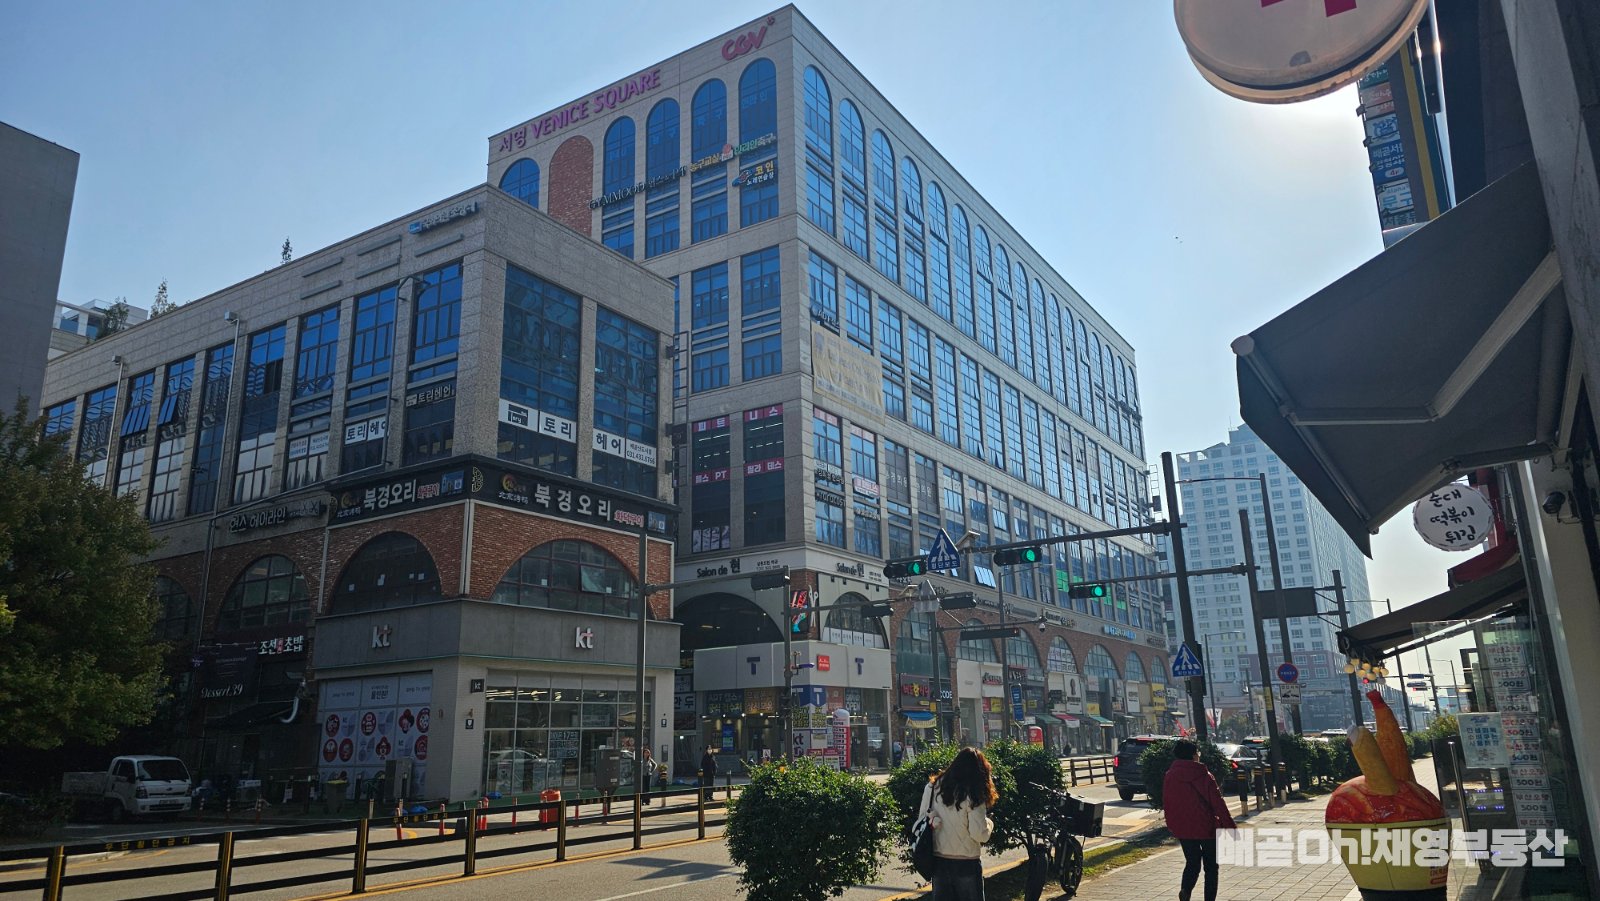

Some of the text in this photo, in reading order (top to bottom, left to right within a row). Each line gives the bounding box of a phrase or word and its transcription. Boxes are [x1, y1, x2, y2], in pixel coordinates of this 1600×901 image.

[721, 25, 769, 61] CGV
[498, 68, 662, 153] 서영 VENICE SQUARE
[754, 159, 775, 177] 코인
[746, 171, 775, 187] 노래연습장
[417, 383, 452, 404] 토리헤어
[346, 422, 367, 442] 토리
[543, 416, 622, 455] 토리 헤어
[695, 470, 727, 484] 헬스 PT
[363, 478, 417, 511] 북경오리
[533, 482, 612, 522] 북경오리
[1429, 488, 1462, 508] 순대
[1430, 506, 1475, 527] 떡볶이
[696, 565, 717, 579] Salon
[718, 565, 728, 576] de
[931, 560, 958, 570] 횡단보도
[371, 624, 392, 648] kt
[575, 626, 595, 649] kt
[746, 656, 761, 675] T
[854, 657, 865, 675] T
[474, 682, 481, 690] kt
[813, 687, 823, 705] T
[793, 733, 804, 745] kt
[1516, 779, 1542, 787] 500원
[1521, 804, 1548, 812] 500원
